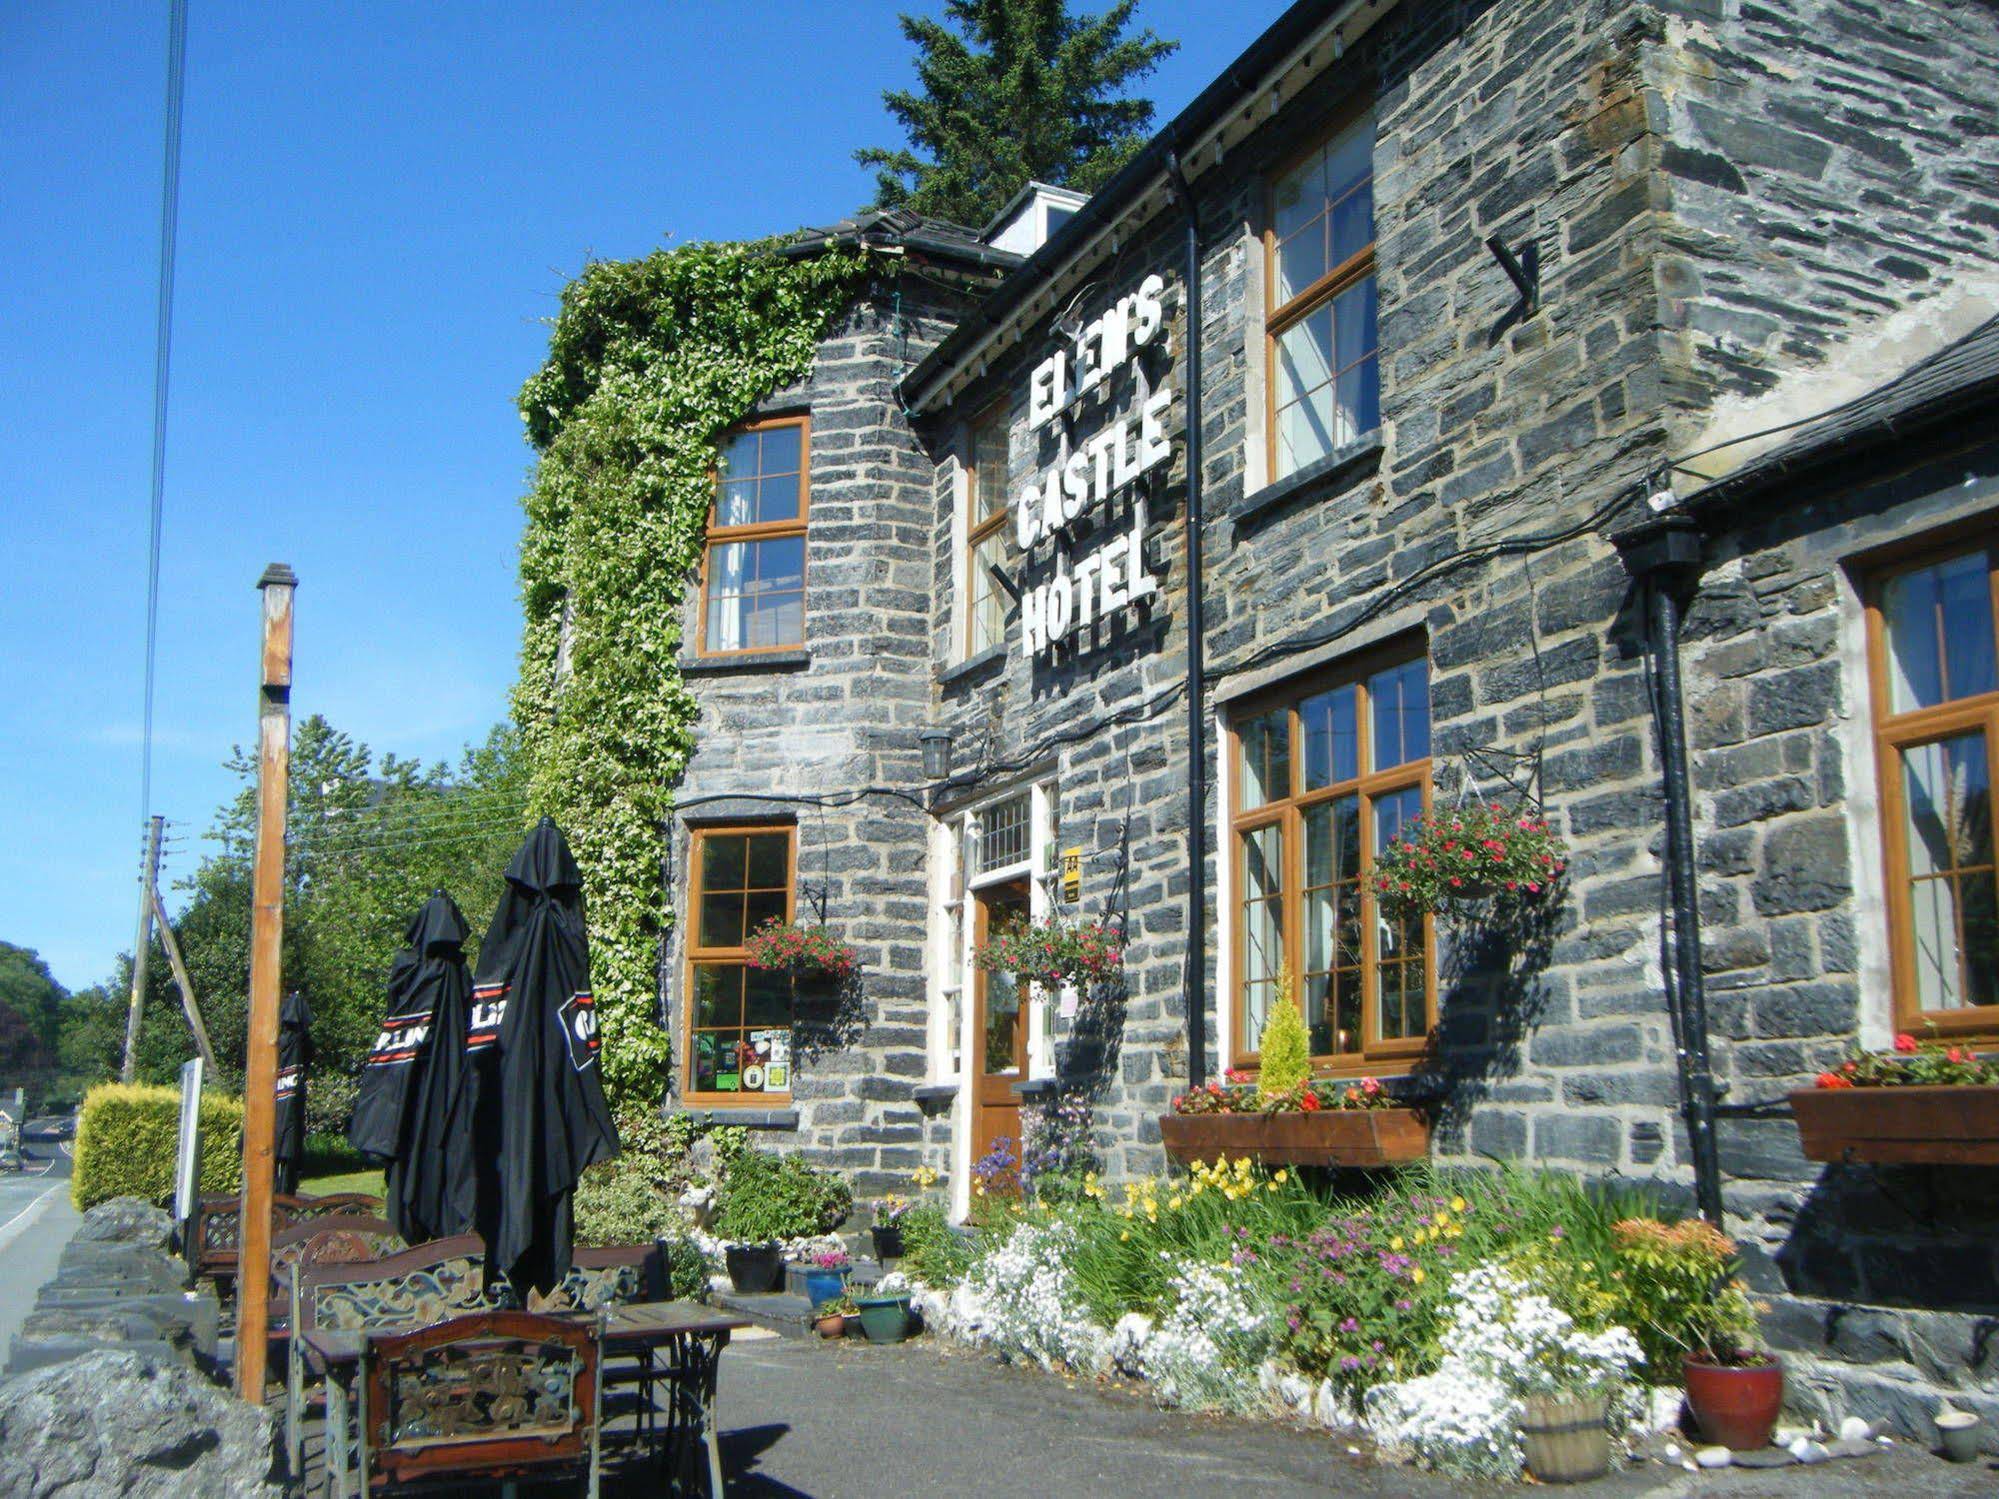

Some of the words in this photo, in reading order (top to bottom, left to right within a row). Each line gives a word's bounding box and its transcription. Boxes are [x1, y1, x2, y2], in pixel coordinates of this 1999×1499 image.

[1029, 273, 1164, 431] ELEN'S
[1018, 388, 1171, 550] CASTLE
[1022, 528, 1156, 658] HOTEL
